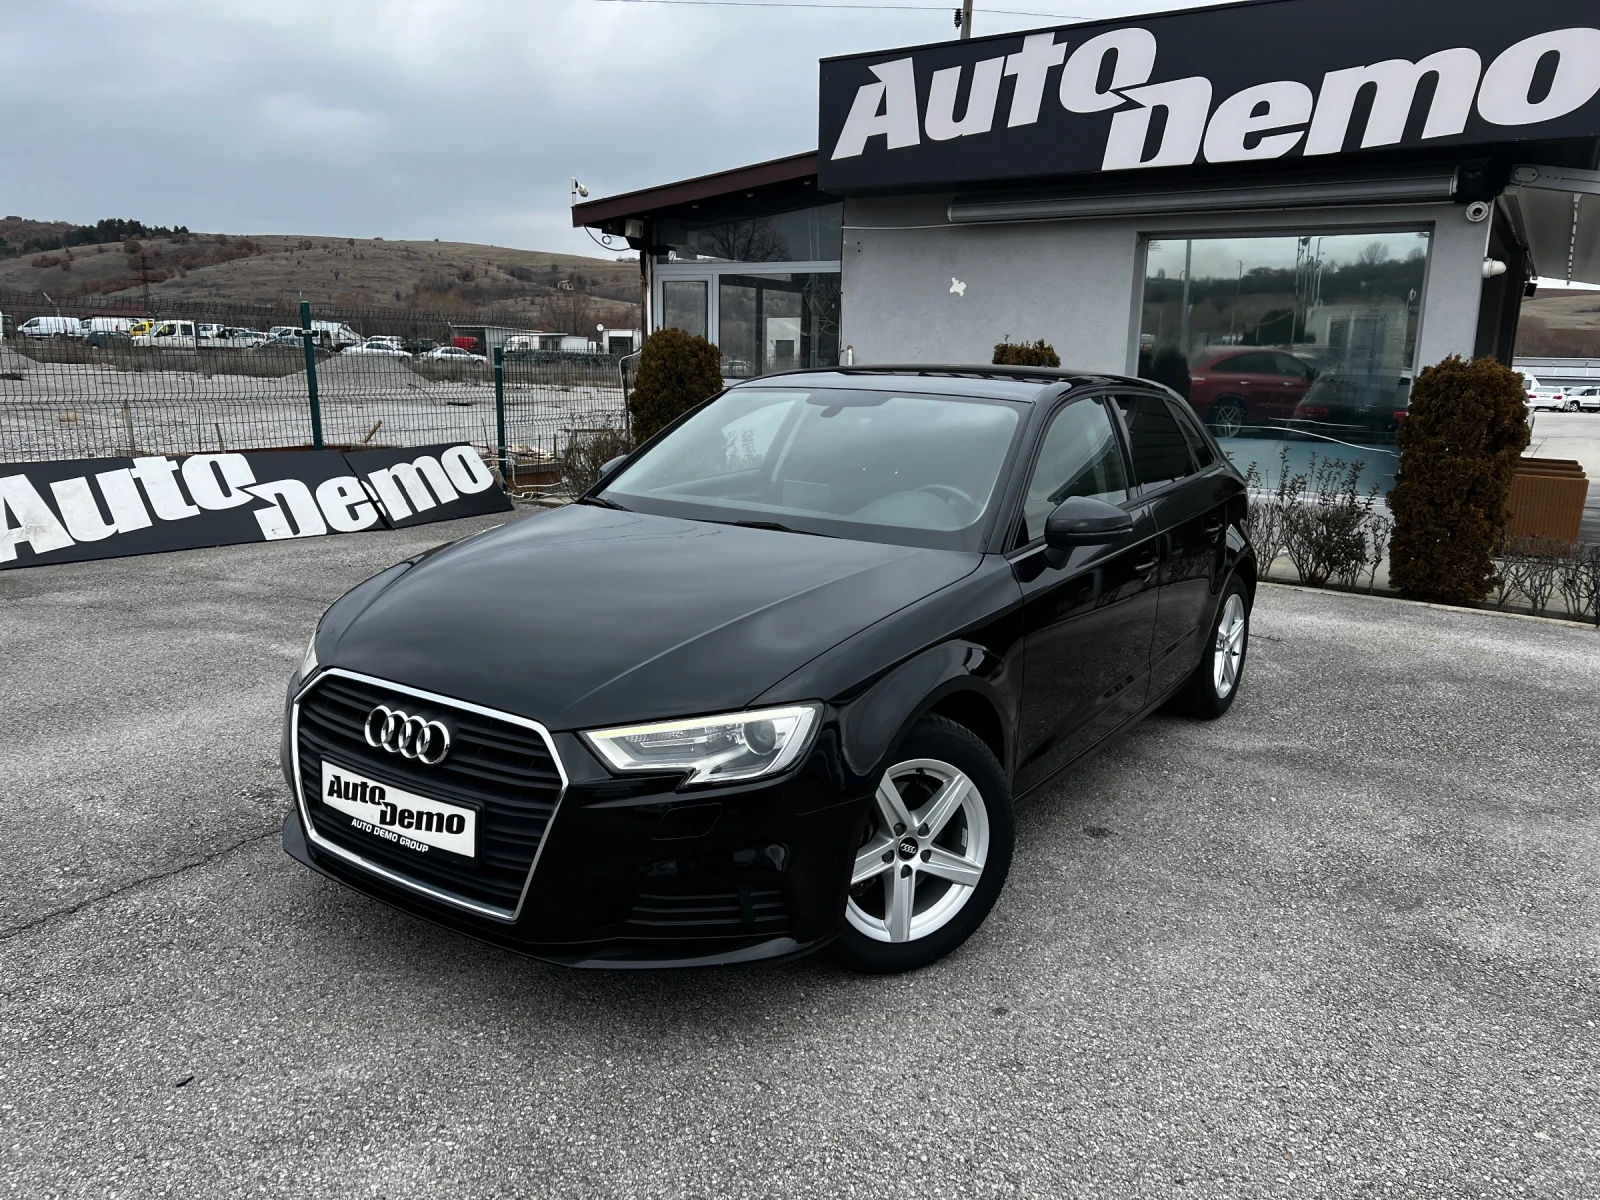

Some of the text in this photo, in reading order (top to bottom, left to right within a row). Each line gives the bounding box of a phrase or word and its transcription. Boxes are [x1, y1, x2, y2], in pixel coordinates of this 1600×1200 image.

[831, 27, 1156, 160] Auto
[1101, 27, 1600, 171] Demo
[0, 453, 256, 563] Auto
[241, 445, 494, 541] Demo
[327, 774, 386, 806] Auto
[351, 818, 429, 853] AUTO DEMO GROUP
[379, 800, 466, 835] Demo
